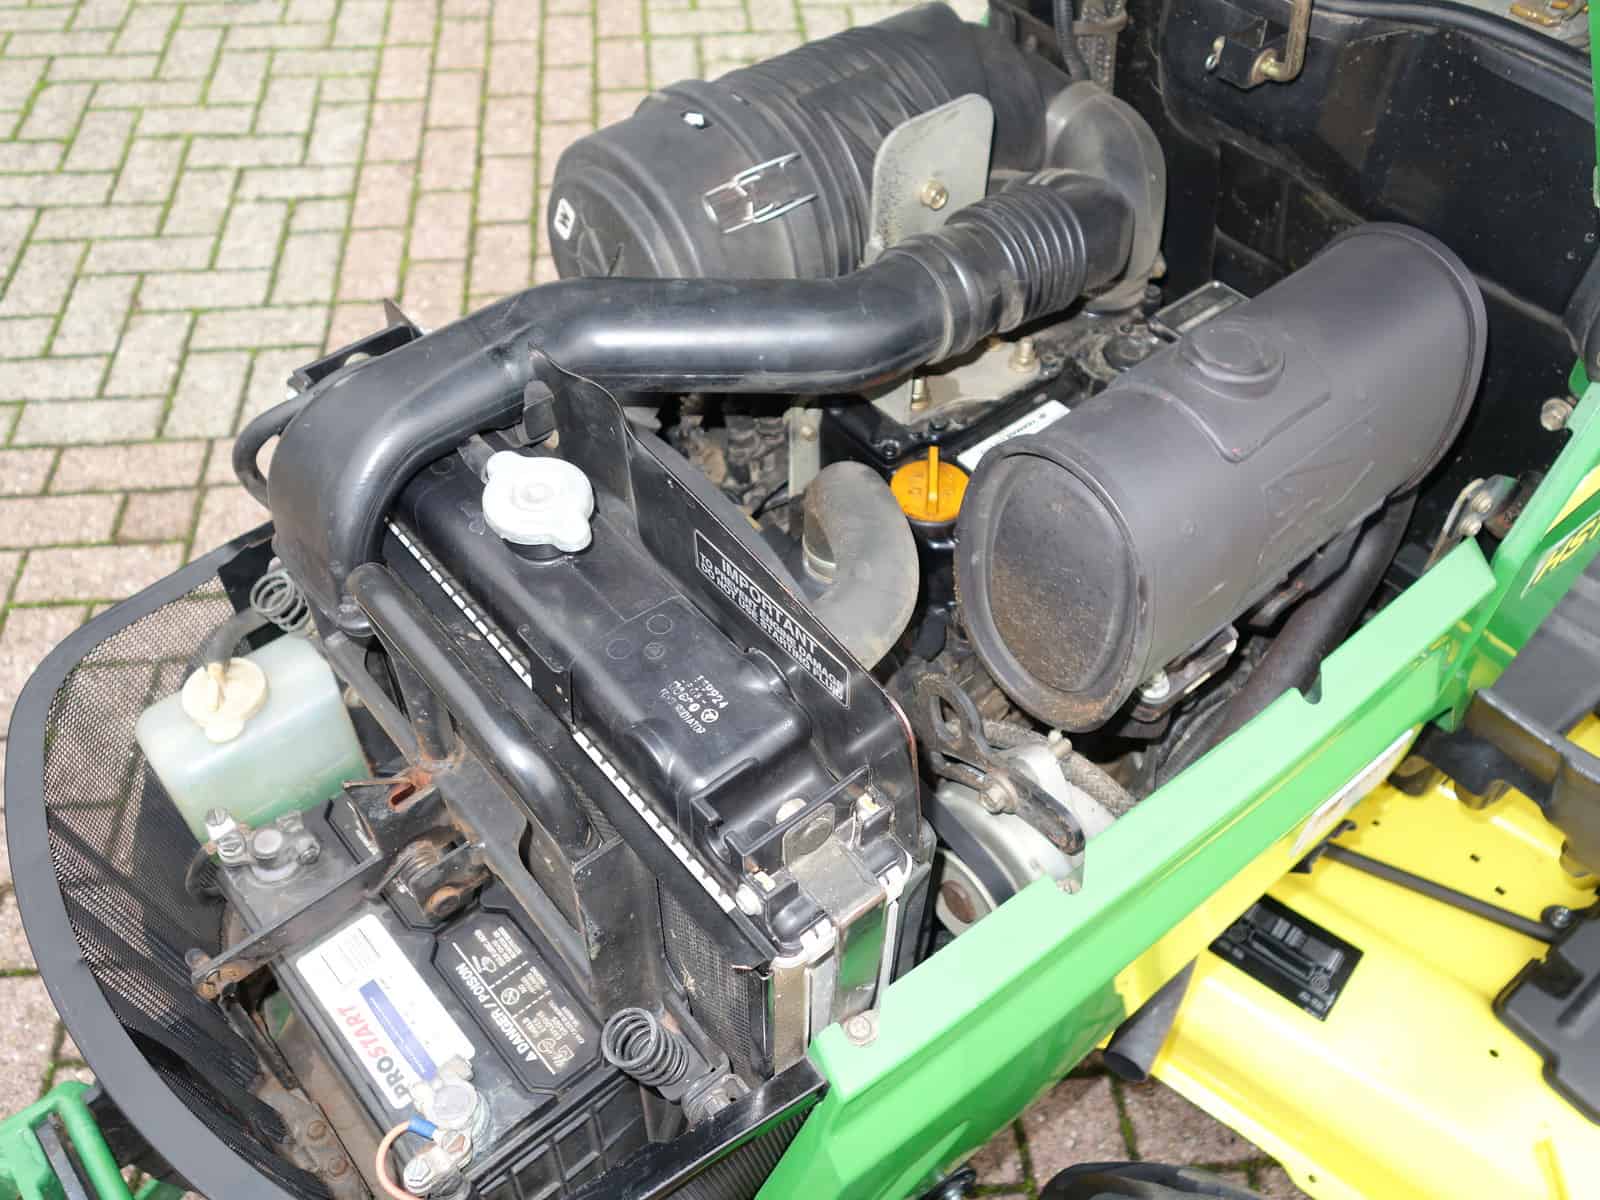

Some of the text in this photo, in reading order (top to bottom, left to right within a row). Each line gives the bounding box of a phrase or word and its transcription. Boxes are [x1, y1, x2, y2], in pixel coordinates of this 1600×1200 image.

[700, 552, 712, 571] TO
[721, 557, 816, 657] IMPORTANT
[455, 962, 490, 1003] POISON
[337, 1005, 410, 1100] PROSTART
[491, 1007, 532, 1055] DANGER
